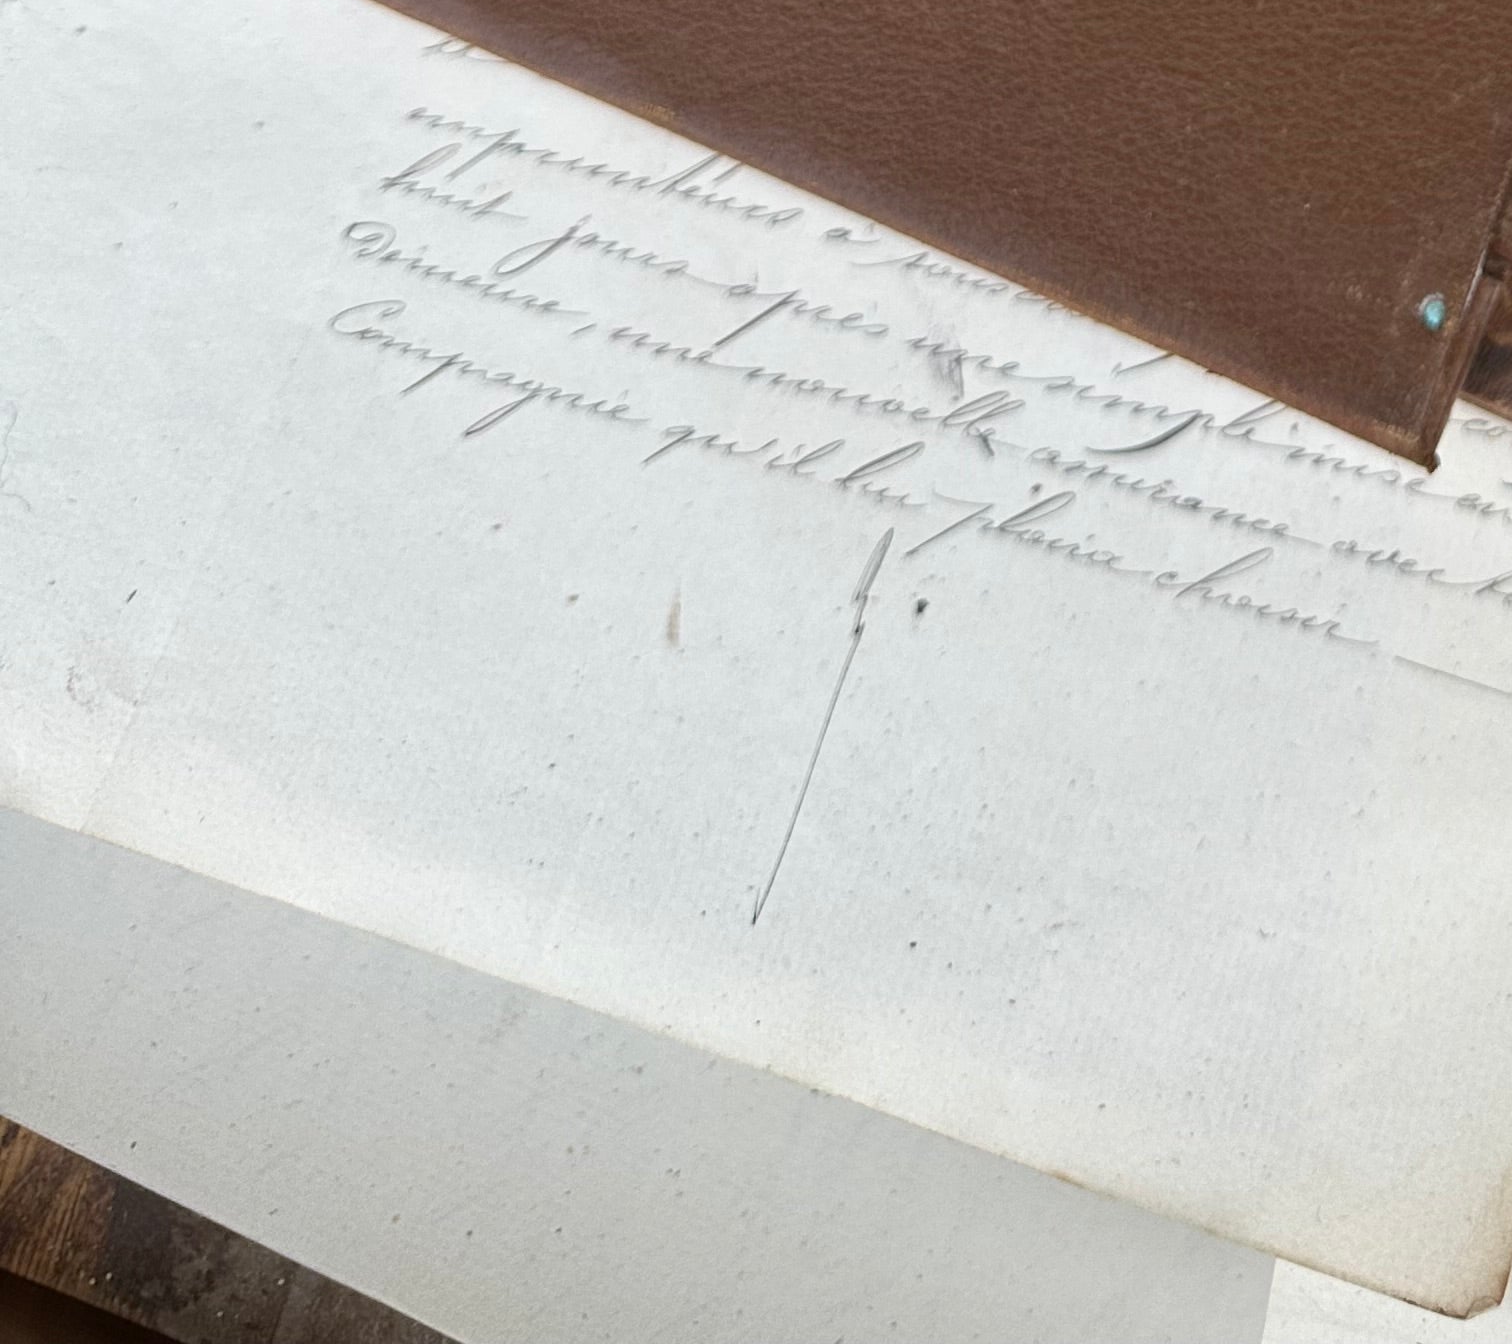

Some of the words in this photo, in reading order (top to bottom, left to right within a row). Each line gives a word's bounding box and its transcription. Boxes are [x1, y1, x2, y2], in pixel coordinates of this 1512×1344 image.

[381, 142, 527, 220] huit
[329, 300, 650, 437] Compagnie
[1026, 445, 1293, 538] assurance
